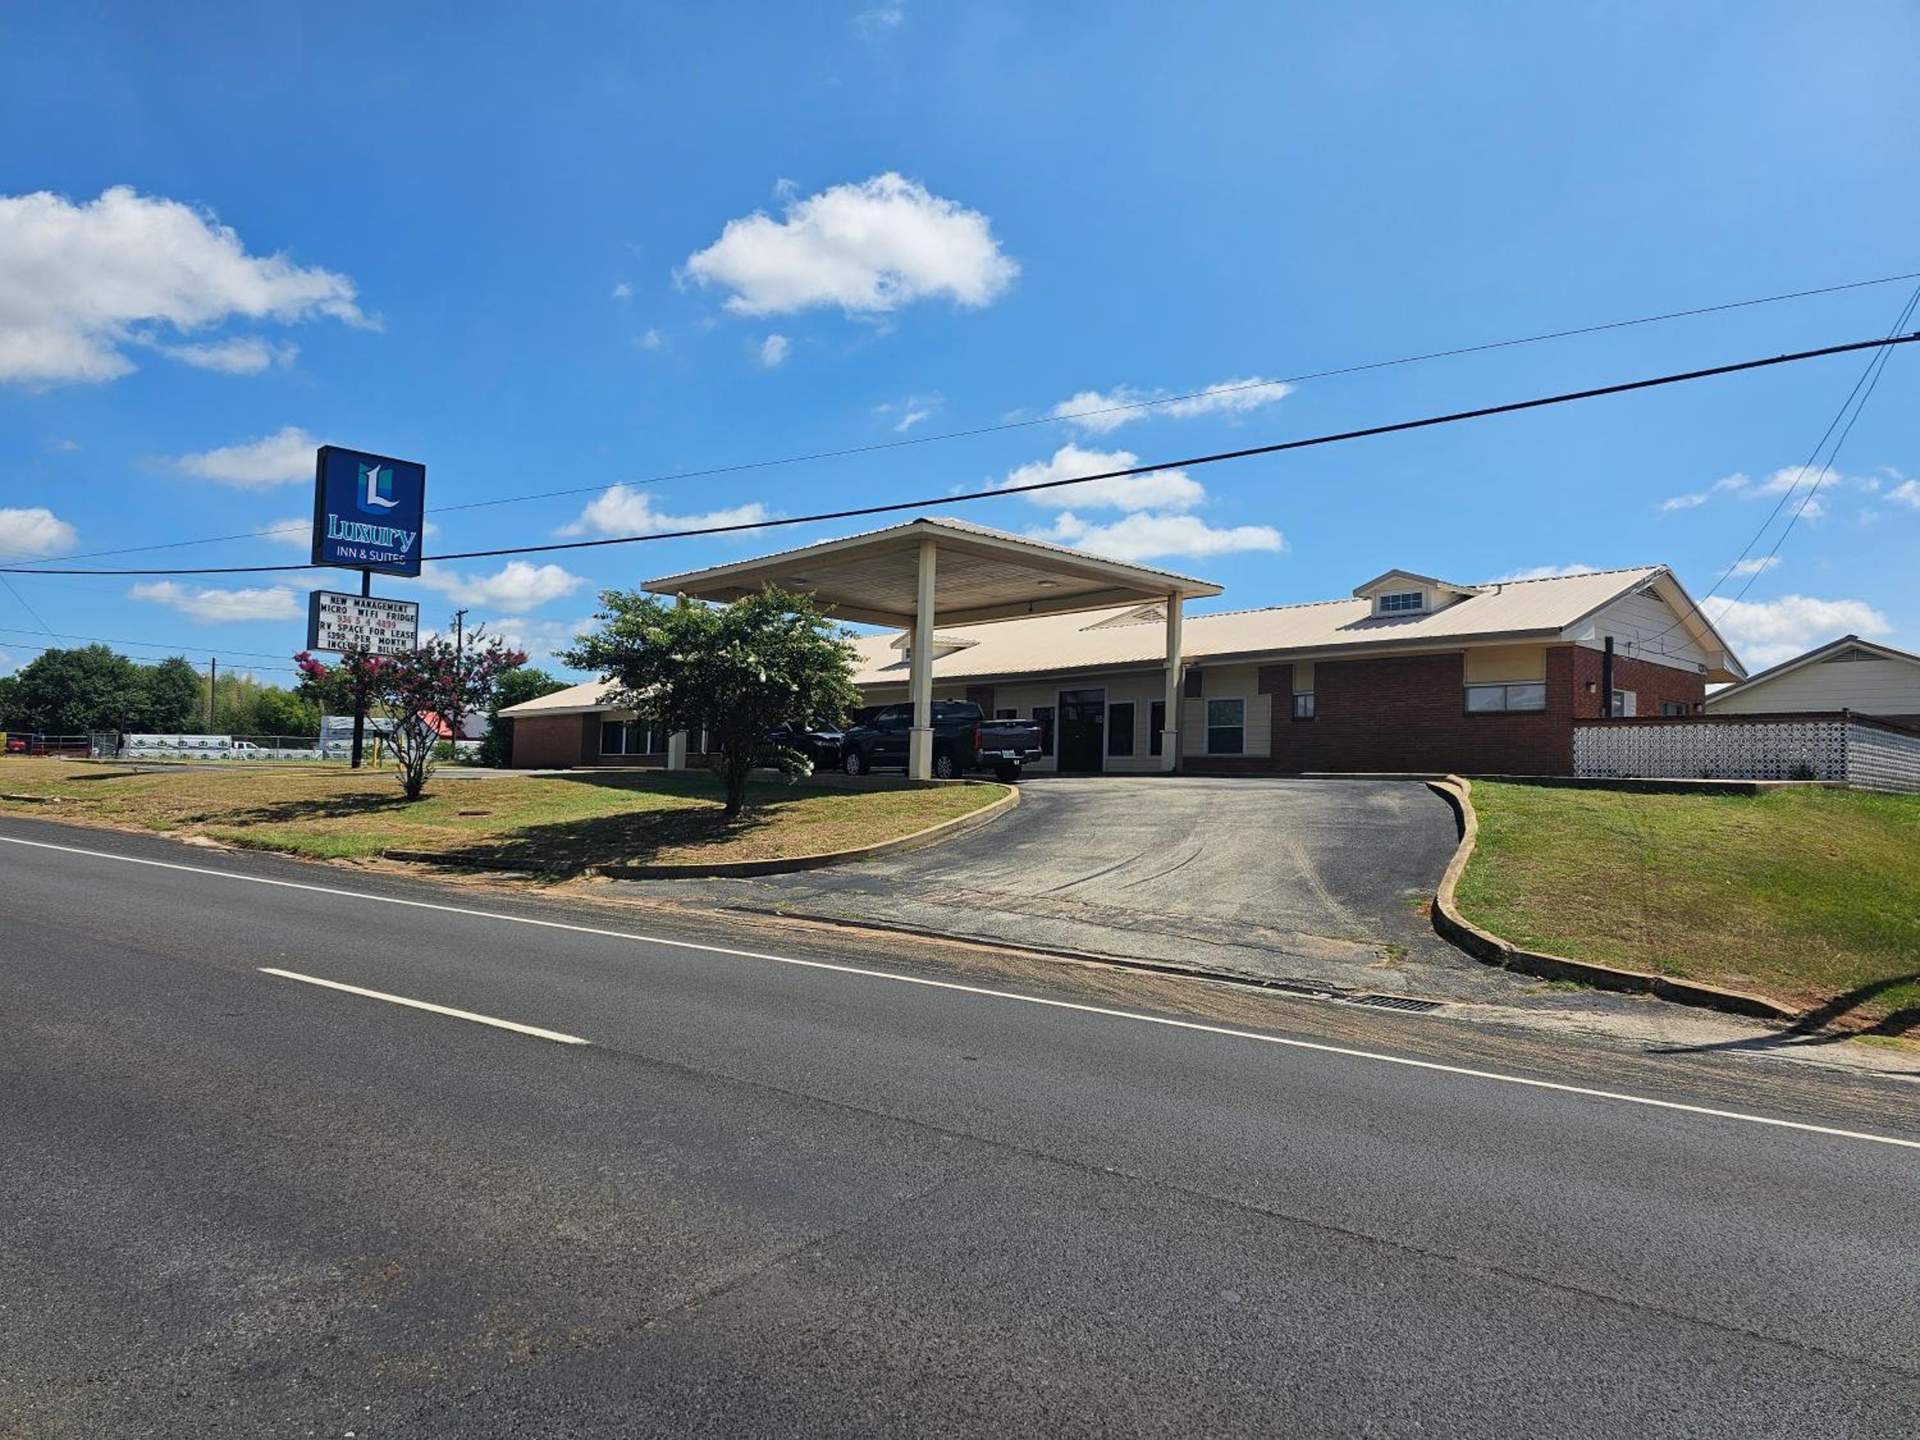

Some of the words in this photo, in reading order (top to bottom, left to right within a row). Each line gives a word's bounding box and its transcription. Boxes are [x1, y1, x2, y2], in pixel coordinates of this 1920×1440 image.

[366, 464, 400, 508] L
[327, 513, 417, 553] Luxury
[337, 545, 357, 558] INN
[359, 549, 367, 559] &
[369, 550, 406, 565] SUITES
[321, 604, 347, 614] MICRO
[359, 610, 378, 619] WIFI
[387, 613, 415, 623] FRIDGE
[331, 596, 347, 605] NEW
[354, 600, 408, 613] MANAGEMENT
[321, 622, 332, 630] RV
[338, 624, 364, 633] SPACE
[370, 628, 386, 636] FOR
[392, 631, 416, 640] LEASE
[355, 635, 371, 643] PER
[379, 638, 407, 646] MONTH
